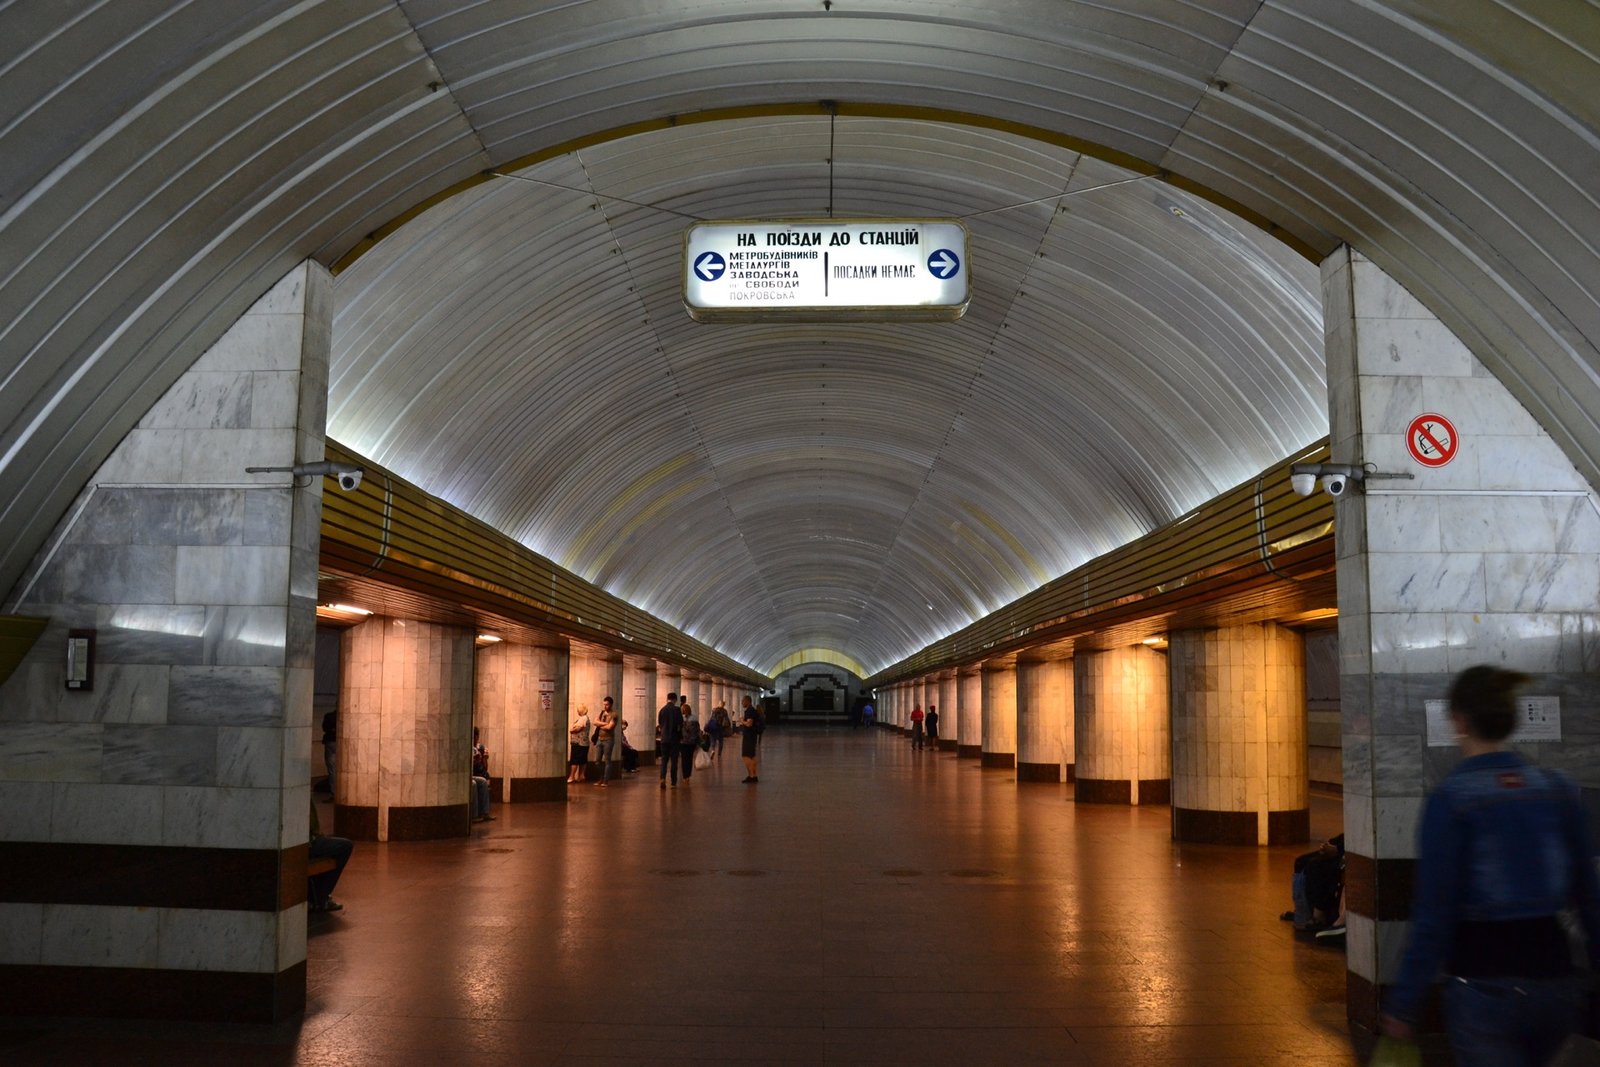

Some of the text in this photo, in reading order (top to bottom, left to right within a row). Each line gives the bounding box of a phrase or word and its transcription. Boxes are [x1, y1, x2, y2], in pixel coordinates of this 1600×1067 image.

[737, 228, 919, 246] НА ПОЇЗДИ ДО СТАНЦІЙ
[729, 250, 818, 260] МЕТРОБУДІВНИКІВ
[729, 260, 790, 270] МЕТАЛУРГІВ
[730, 270, 799, 279] ЗАВОДСЬКА
[881, 264, 916, 279] НЕМАЄ
[745, 280, 800, 289] СВОБОДИ
[729, 291, 795, 301] ПОКРОВСЬКА
